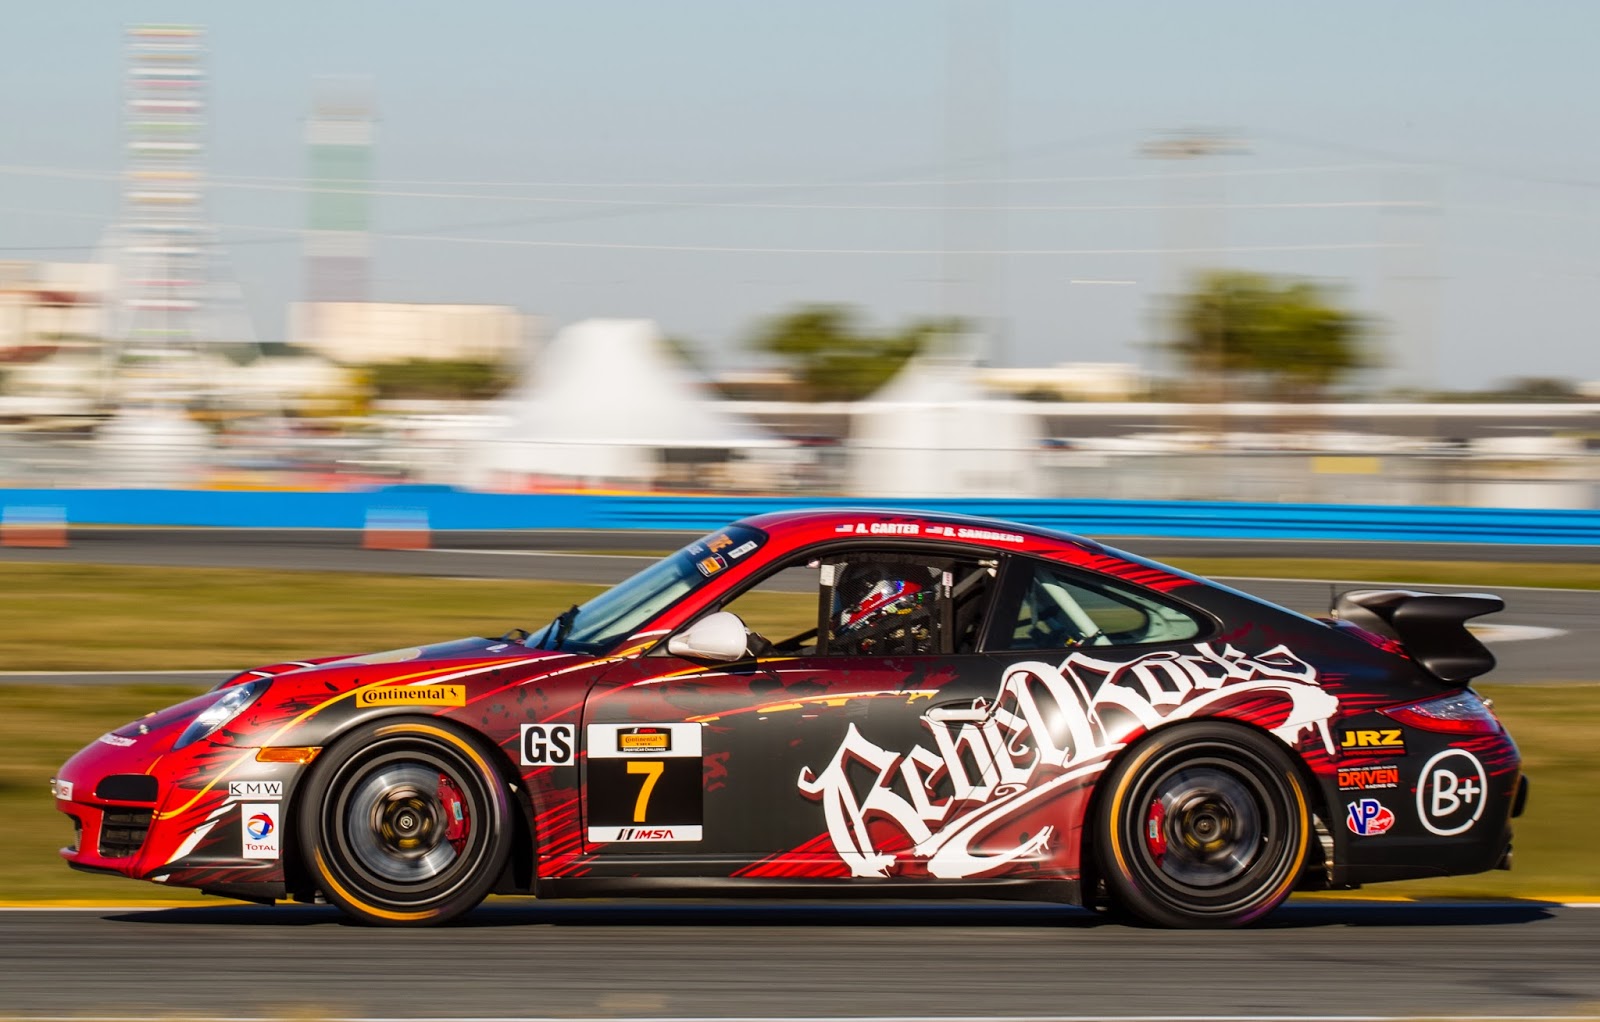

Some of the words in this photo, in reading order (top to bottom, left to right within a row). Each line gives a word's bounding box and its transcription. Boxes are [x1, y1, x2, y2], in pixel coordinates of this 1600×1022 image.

[855, 523, 868, 533] A.
[870, 523, 919, 534] CARTER
[943, 527, 956, 537] B.
[957, 528, 1024, 543] SANDBERG
[362, 688, 445, 703] Continental
[524, 726, 571, 763] GS
[1341, 730, 1404, 747] JRZ
[1338, 769, 1399, 789] DRIVEN
[230, 783, 280, 794] KMW
[627, 761, 664, 822] 7
[1431, 769, 1480, 817] B+
[1347, 799, 1380, 835] VP
[634, 830, 674, 839] IMSA
